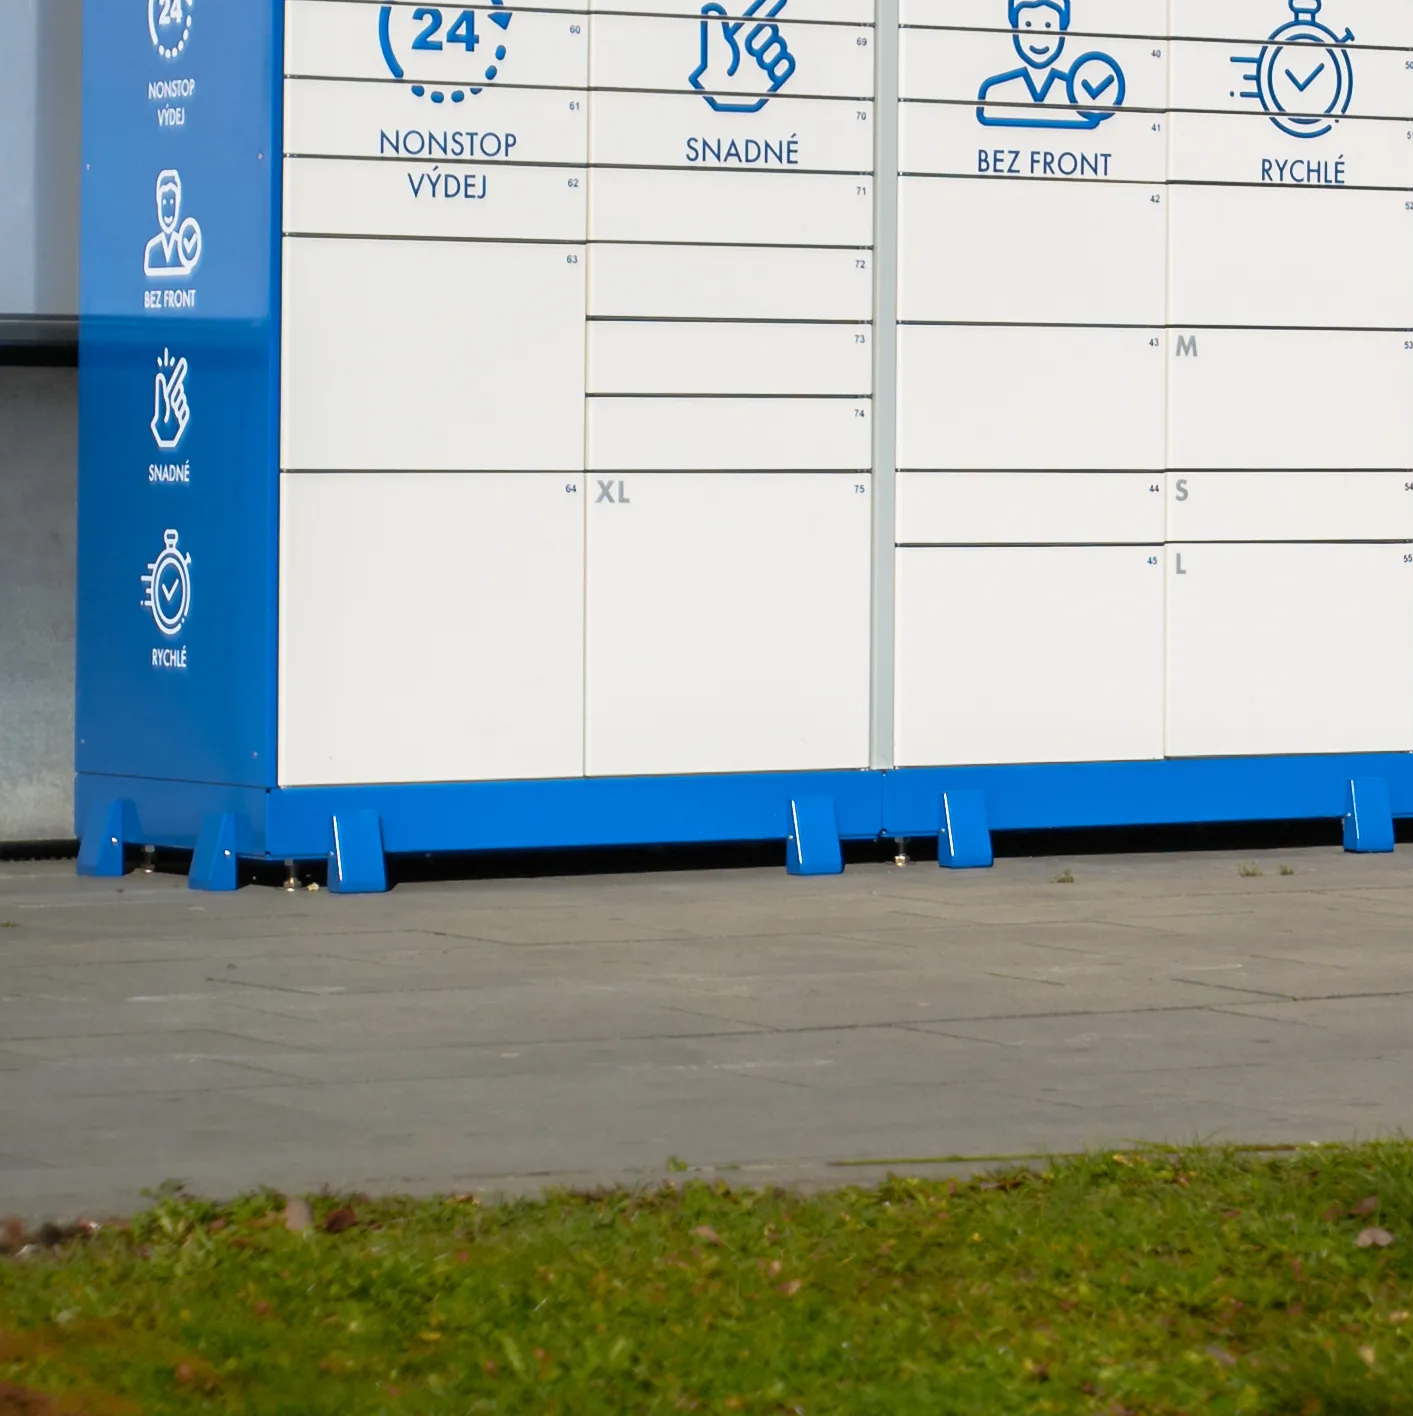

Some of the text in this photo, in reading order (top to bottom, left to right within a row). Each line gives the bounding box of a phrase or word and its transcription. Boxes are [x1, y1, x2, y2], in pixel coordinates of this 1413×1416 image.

[411, 8, 480, 53] 24
[570, 25, 580, 34] 60
[857, 37, 867, 46] 69
[1151, 50, 1161, 58] 40
[1405, 61, 1413, 69] 50
[148, 78, 196, 100] NONSTOP
[569, 101, 579, 110] 61
[157, 104, 185, 127] VÝDEJ
[857, 111, 866, 120] 70
[380, 129, 518, 158] NONSTOP
[686, 133, 800, 166] SNADNÉ
[977, 149, 1113, 178] BEZ FRONT
[1261, 154, 1345, 184] RYCHLÉ
[407, 166, 487, 200] VÝDEJ
[568, 179, 578, 187] 62
[857, 187, 866, 195] 71
[1150, 195, 1160, 203] 42
[1405, 201, 1413, 210] 52
[567, 255, 577, 263] 63
[856, 260, 865, 268] 72
[144, 289, 196, 309] BEZ FRONT
[855, 335, 865, 343] 73
[1149, 338, 1159, 346] 43
[1175, 335, 1198, 357] M
[1405, 341, 1413, 349] 53
[855, 409, 864, 417] 74
[148, 460, 190, 483] SNADNÉ
[566, 484, 576, 493] 64
[595, 481, 630, 503] XL
[855, 485, 865, 493] 75
[1175, 479, 1188, 501] S
[1176, 553, 1187, 574] L
[151, 646, 187, 669] RYCHLÉ
